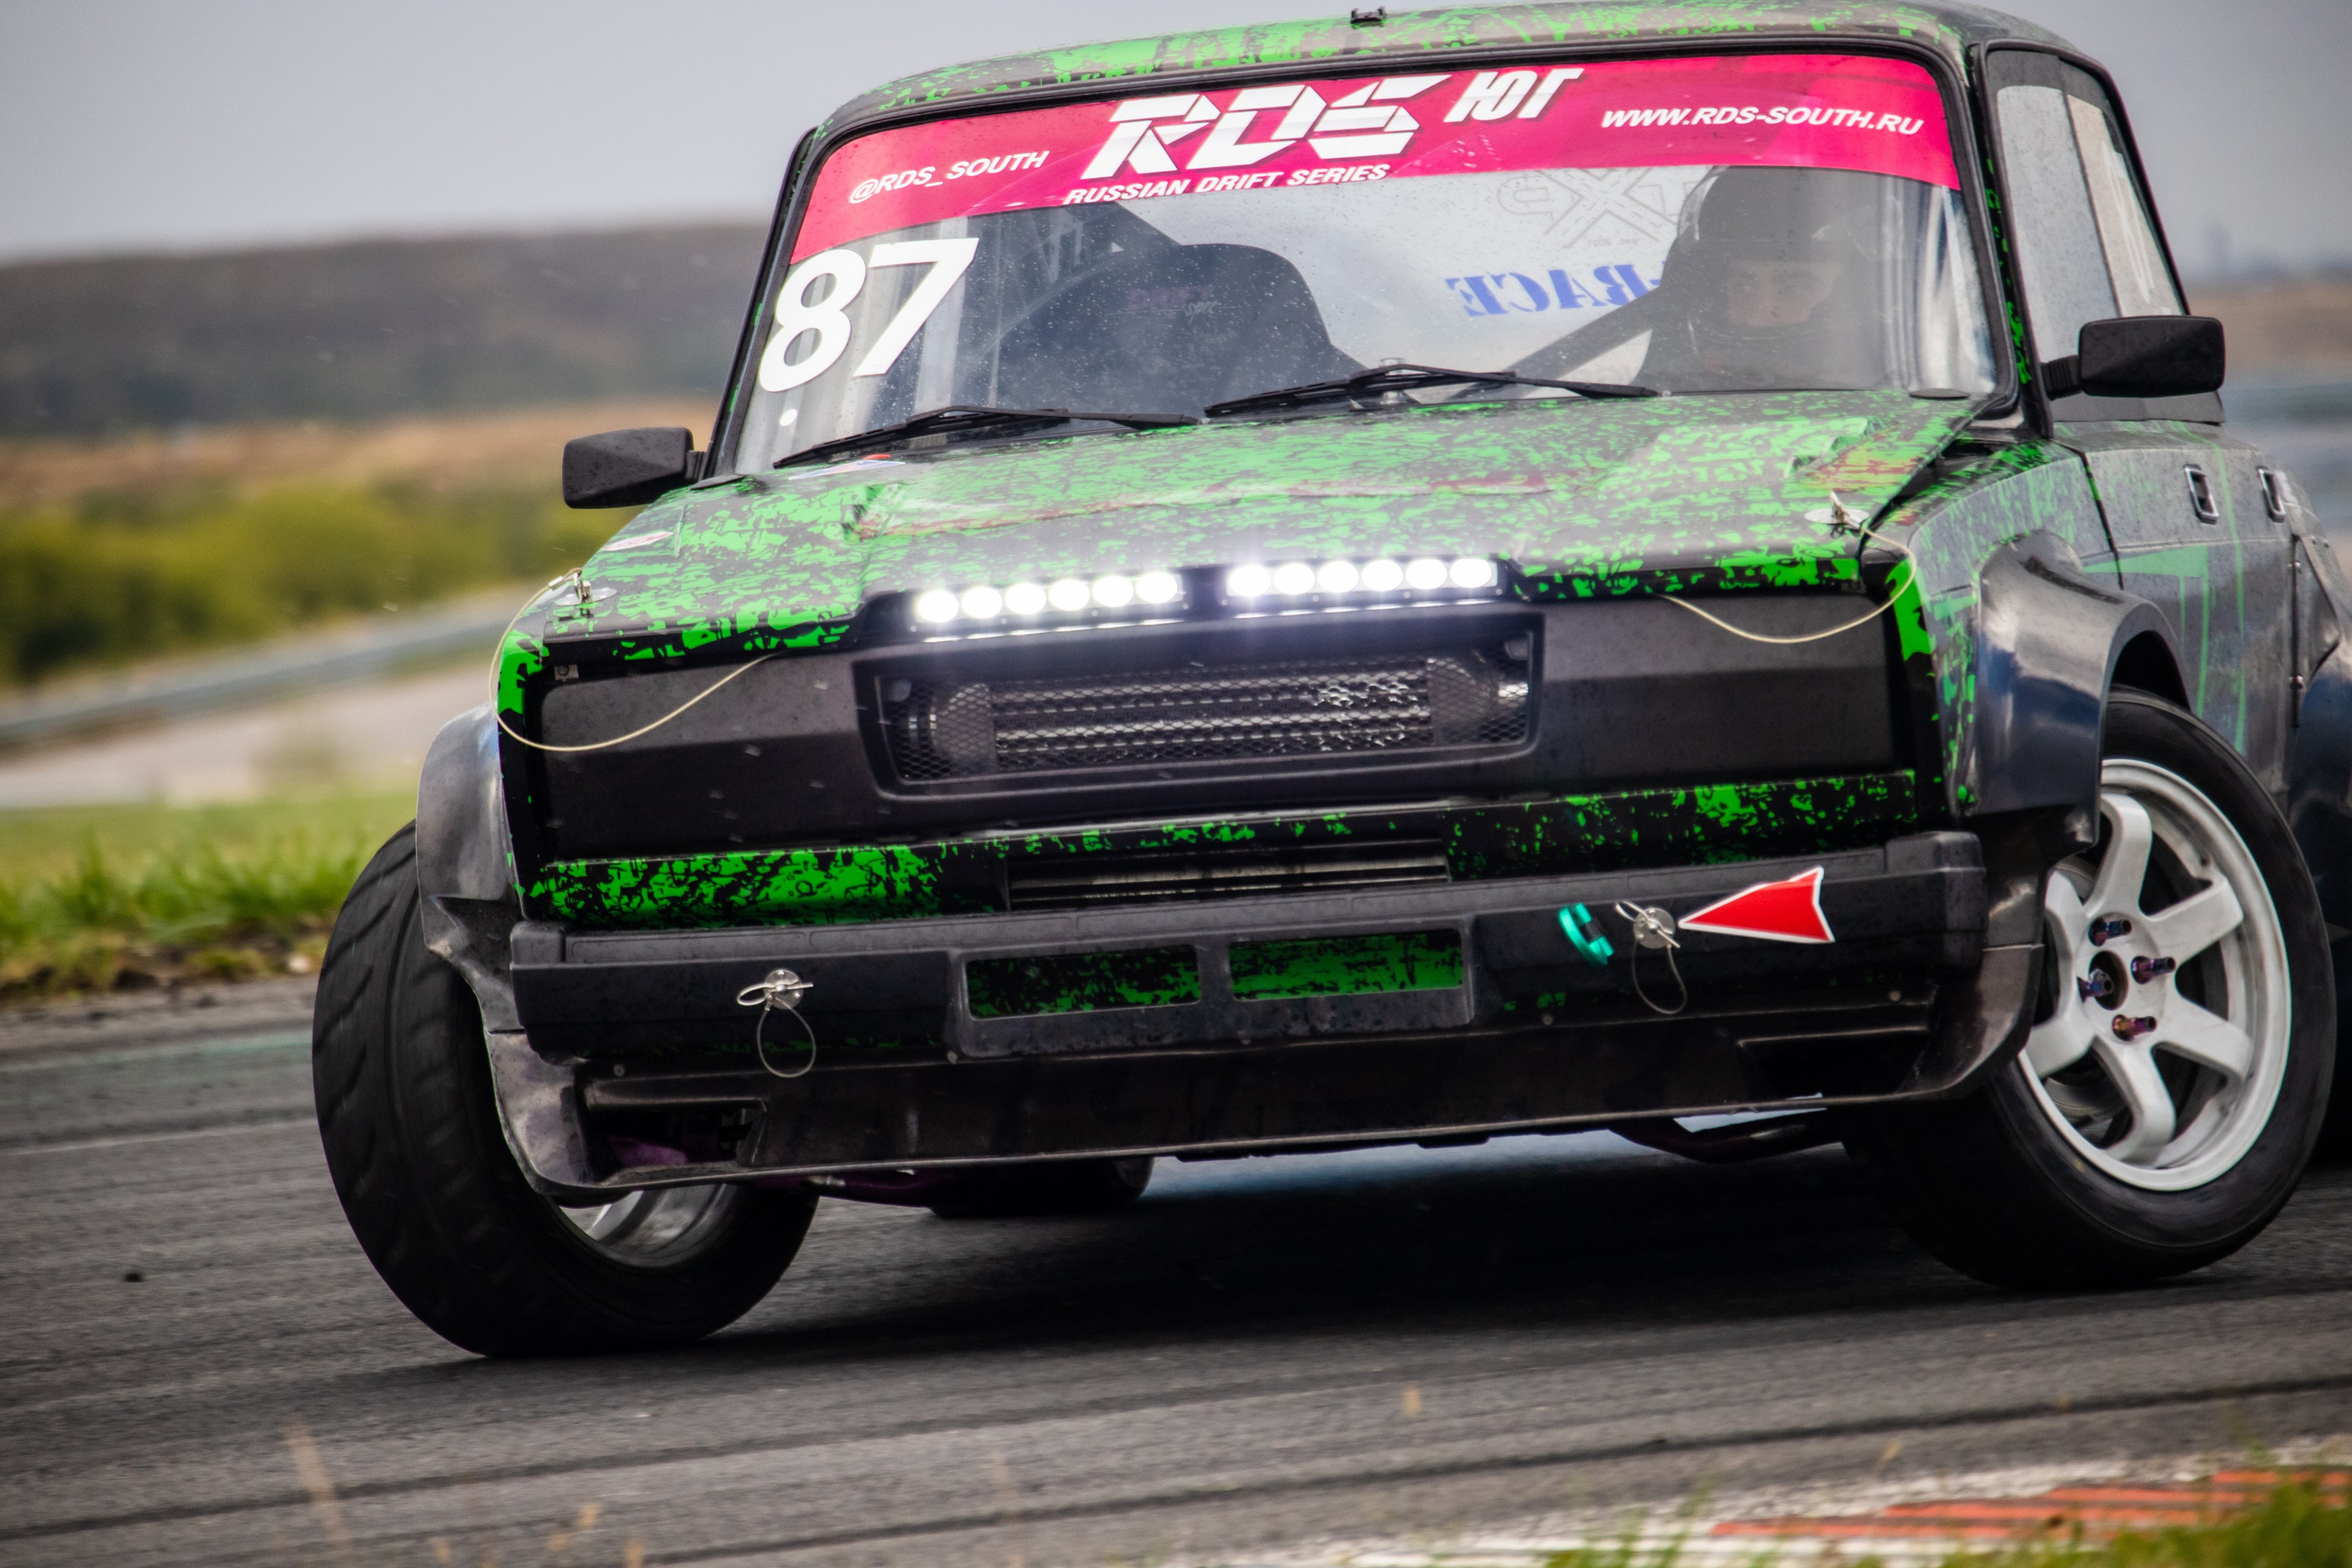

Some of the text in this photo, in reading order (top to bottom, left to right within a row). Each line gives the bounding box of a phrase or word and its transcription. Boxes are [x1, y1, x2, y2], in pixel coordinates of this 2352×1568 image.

[1444, 68, 1585, 123] ЮГ
[1601, 107, 1923, 135] WWW.RDS-SOUTH.RU
[1080, 75, 1453, 179] RDS
[849, 151, 1049, 204] @RDS_SOUTH
[1063, 164, 1391, 205] RUSSIAN DRIFT SERIES
[760, 237, 979, 392] 87
